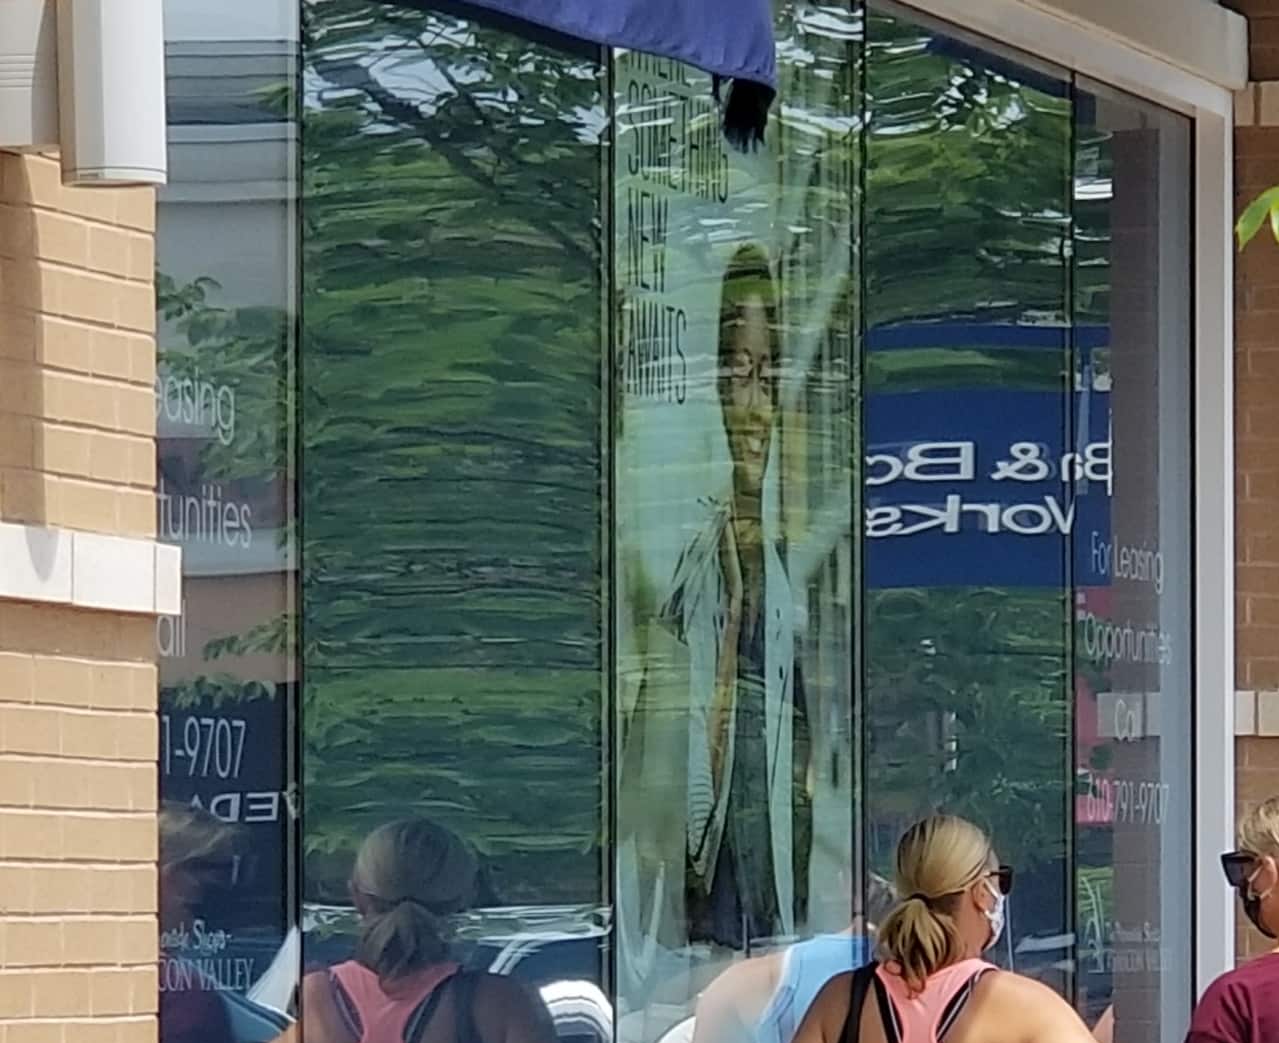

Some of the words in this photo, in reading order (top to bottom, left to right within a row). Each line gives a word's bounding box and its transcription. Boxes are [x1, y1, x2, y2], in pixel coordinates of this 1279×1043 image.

[627, 79, 729, 204] SOMETHING
[627, 186, 669, 294] NEW
[625, 297, 687, 405] AWAITS
[1091, 531, 1112, 575] For
[1114, 535, 1165, 595] Leasing
[1084, 611, 1172, 668] Opportunities
[197, 957, 255, 992] VALLEY
